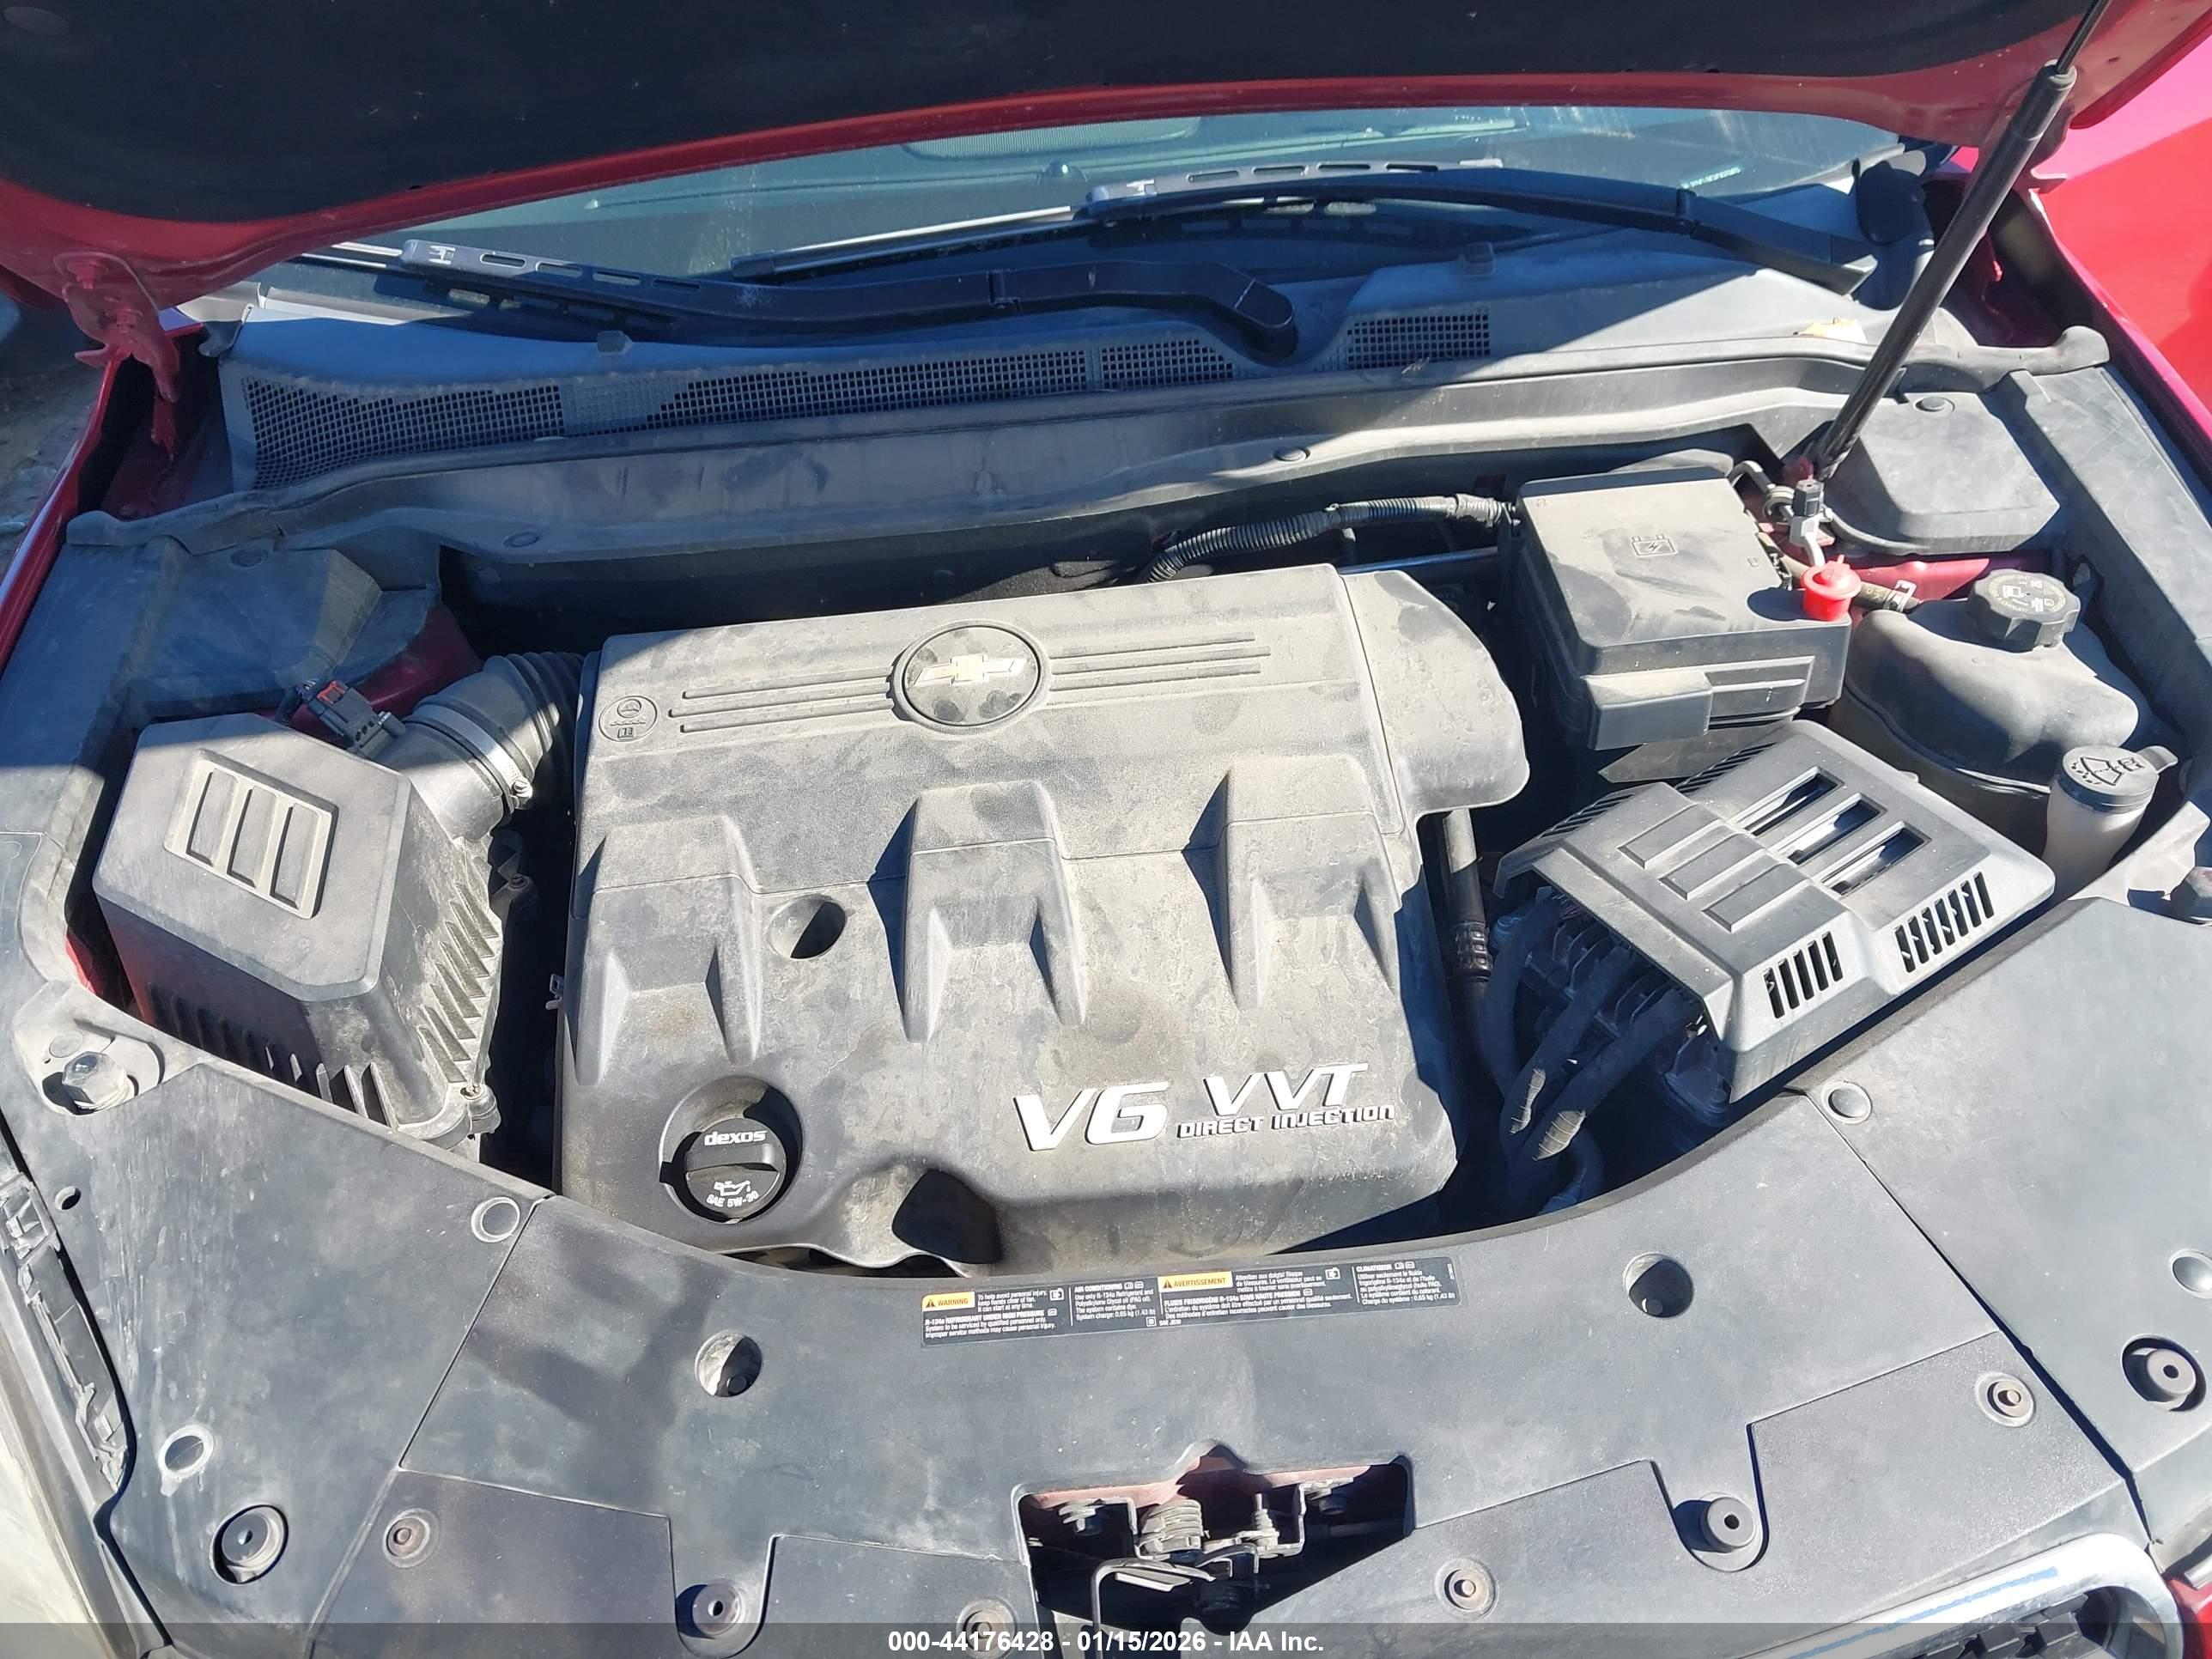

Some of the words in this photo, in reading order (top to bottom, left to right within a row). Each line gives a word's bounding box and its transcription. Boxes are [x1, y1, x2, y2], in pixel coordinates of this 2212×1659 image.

[1203, 1063, 1369, 1116] VVT
[1013, 1081, 1170, 1151] V6
[1177, 1117, 1263, 1139] DIRECT
[1271, 1104, 1395, 1129] INJECTION
[704, 1130, 768, 1146] dexos
[706, 1194, 725, 1207] SAE
[727, 1190, 758, 1207] 5W-30
[1174, 1278, 1225, 1287] AVERTISSEMENT
